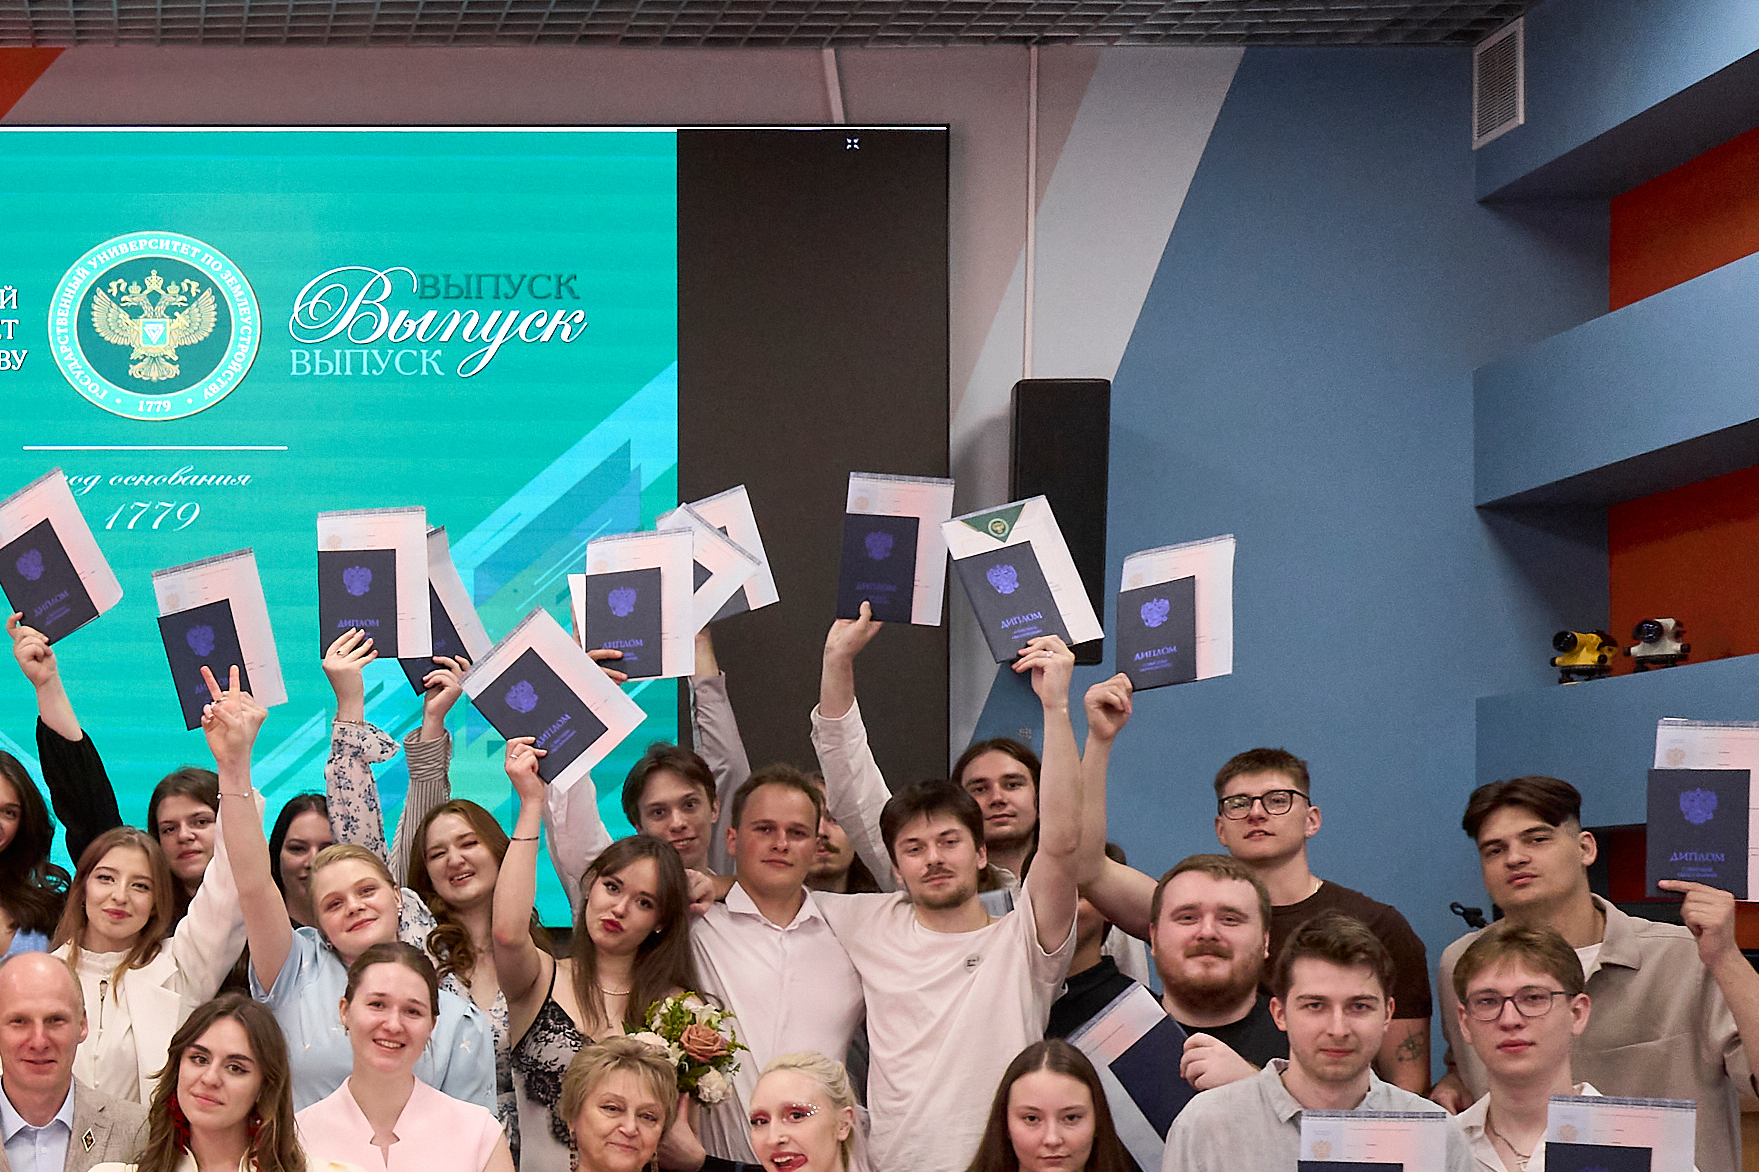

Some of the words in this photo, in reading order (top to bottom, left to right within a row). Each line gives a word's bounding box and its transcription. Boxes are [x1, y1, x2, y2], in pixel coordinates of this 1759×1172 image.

[87, 238, 202, 270] УНИВЕРСИТЕТ
[199, 252, 223, 273] ПО
[418, 273, 581, 300] ВЫПУСК
[55, 265, 109, 401] ГОСУДАРСТВЕННЫЙ
[288, 265, 588, 379] Выпуск
[203, 268, 253, 401] ЗЕМЛЕУСТРОЙСТВУ
[289, 349, 445, 377] ВЫПУСК
[137, 400, 173, 412] 1779
[108, 465, 254, 487] основания
[104, 501, 201, 532] 1779
[336, 618, 380, 628] ДИПЛОМ
[1000, 611, 1043, 630] ДИПЛОМ
[602, 638, 644, 650] ДИПЛОМ
[1132, 645, 1178, 662] ДИПЛОМ
[535, 713, 572, 749] ДИПЛОМ
[1669, 850, 1726, 863] ДИПЛОМ
